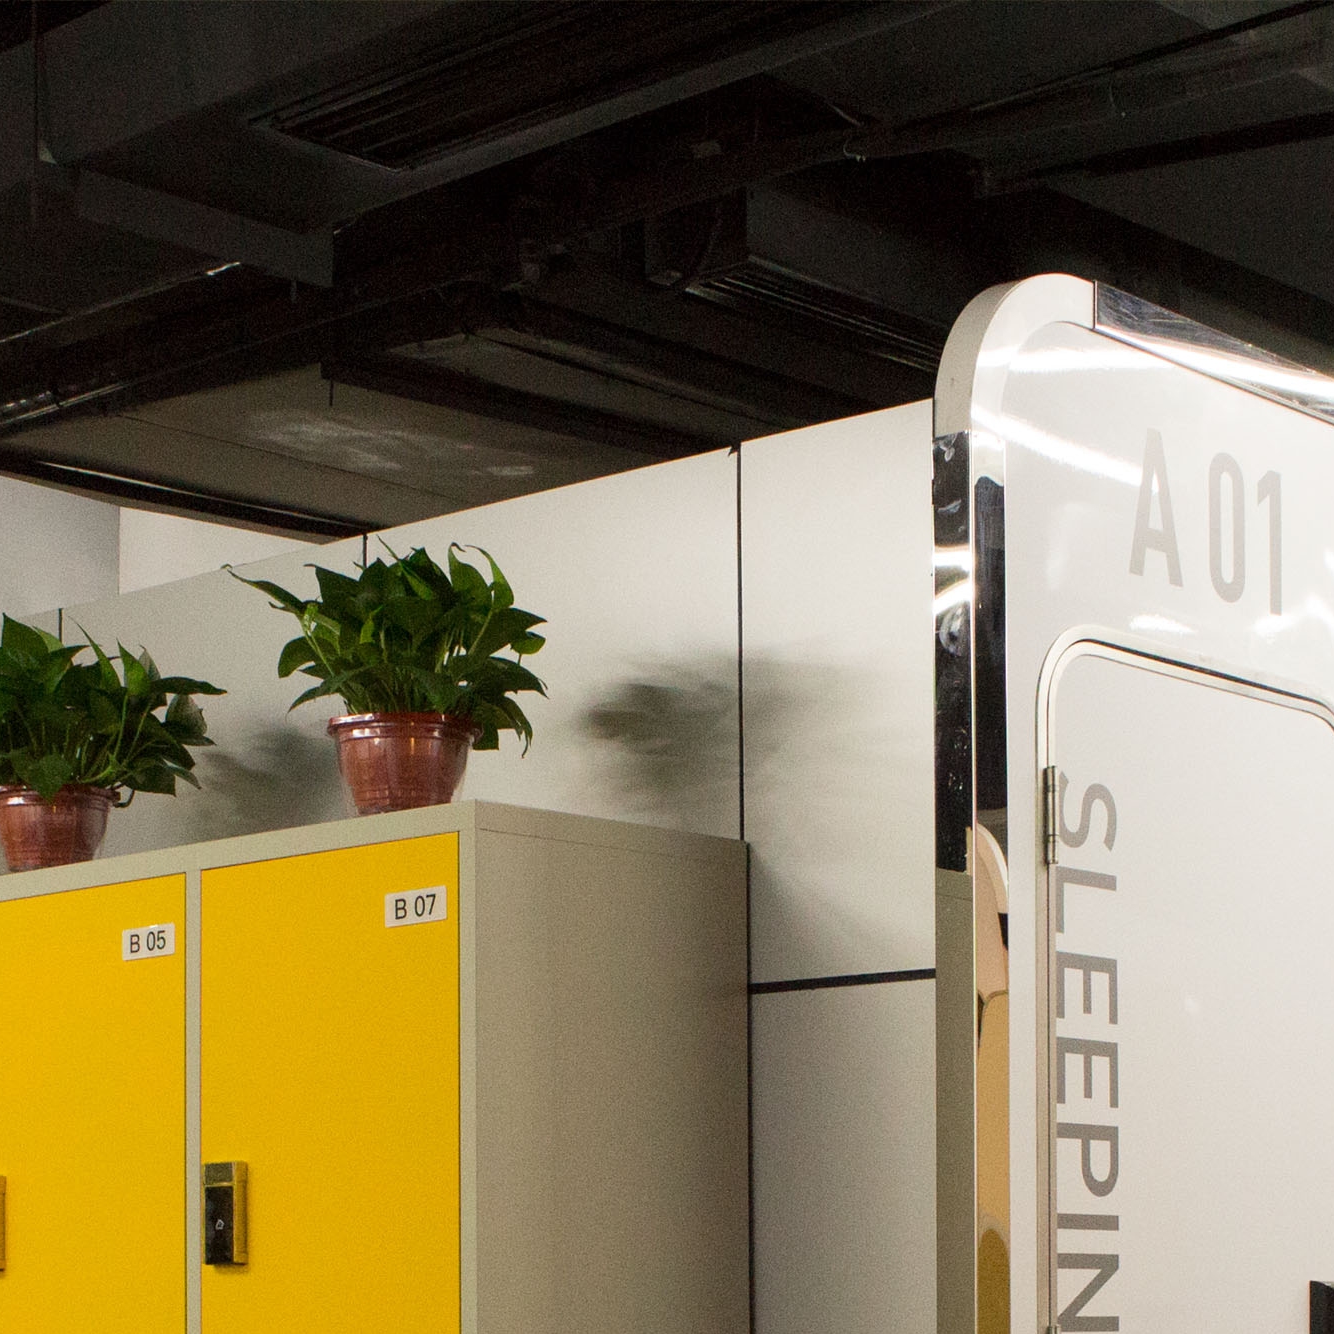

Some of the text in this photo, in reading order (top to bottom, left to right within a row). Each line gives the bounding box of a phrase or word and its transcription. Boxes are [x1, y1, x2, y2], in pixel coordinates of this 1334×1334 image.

[1129, 428, 1283, 616] A 01
[395, 893, 436, 920] B 07
[130, 930, 166, 953] B 05
